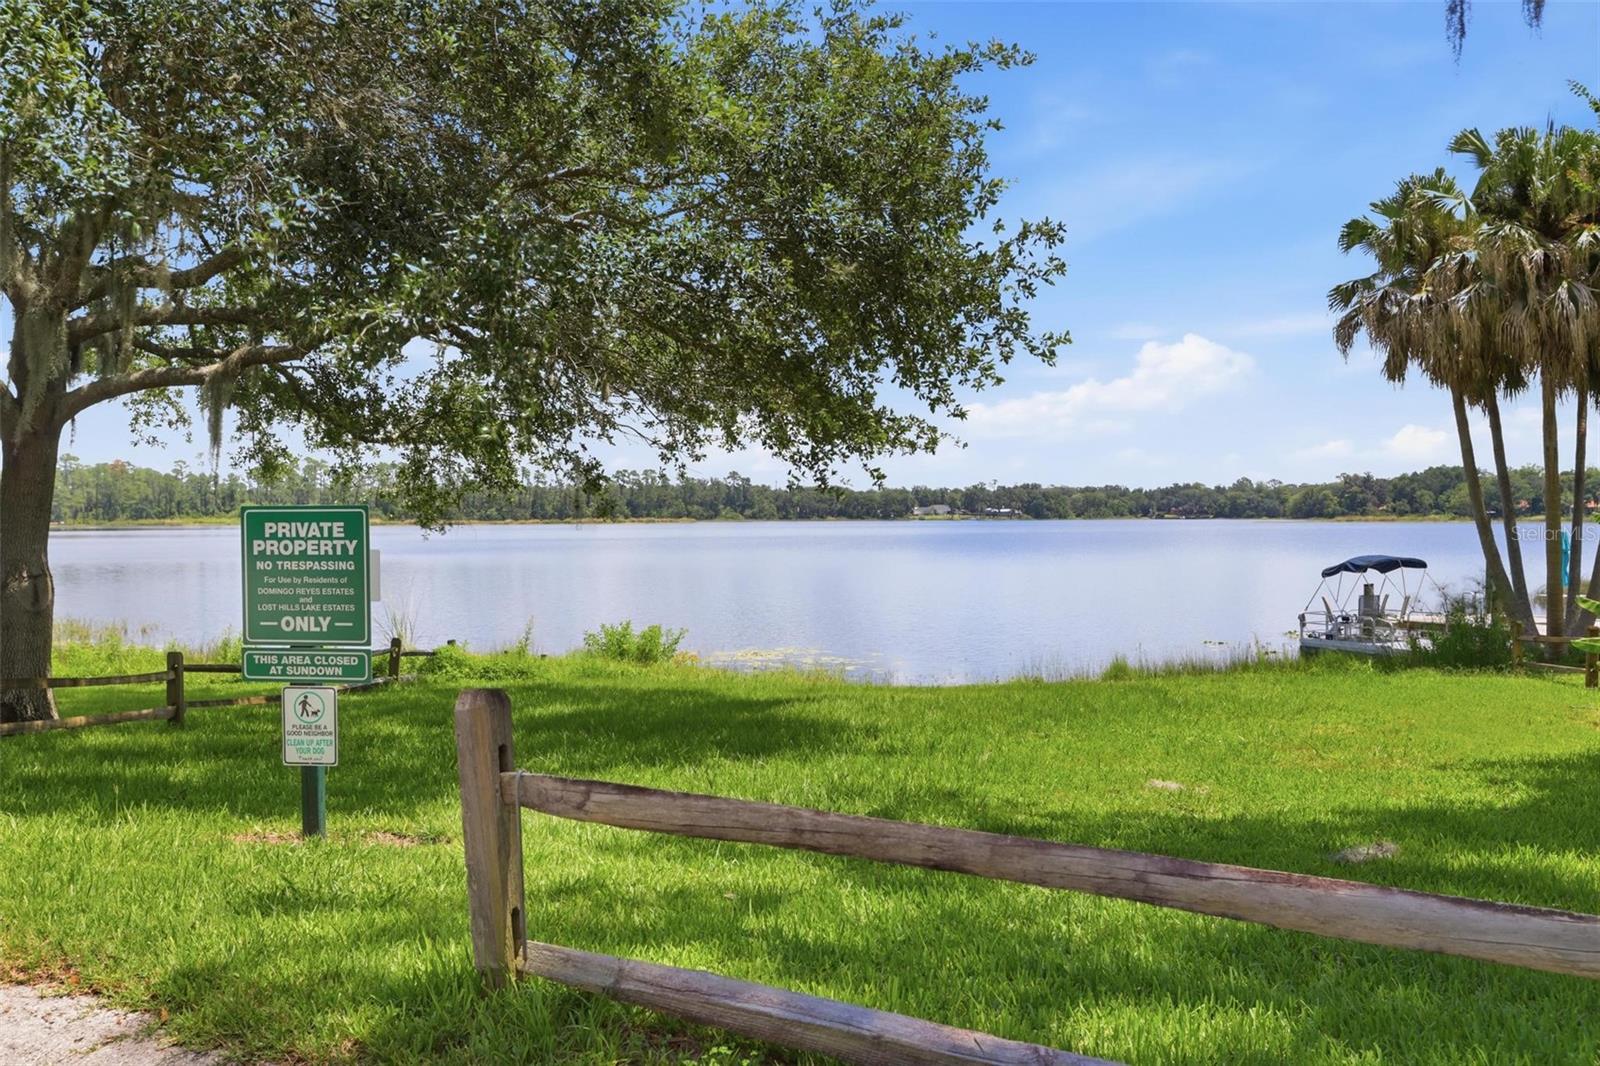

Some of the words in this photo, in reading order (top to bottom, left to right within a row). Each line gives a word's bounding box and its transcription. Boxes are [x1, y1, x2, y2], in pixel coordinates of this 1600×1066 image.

[264, 522, 345, 538] PRIVATE
[253, 540, 358, 555] PROPERTY
[256, 561, 272, 570] NO
[276, 561, 355, 570] TRESPASSING
[293, 576, 301, 584] by
[257, 603, 277, 611] LOST
[278, 603, 300, 611] HILLS
[322, 604, 355, 612] ESTATES
[280, 615, 331, 632] ONLY
[253, 655, 278, 664] THIS
[281, 655, 311, 665] AREA
[314, 656, 358, 665] CLOSED
[269, 666, 283, 674] AT
[286, 666, 343, 676] SUNDOWN
